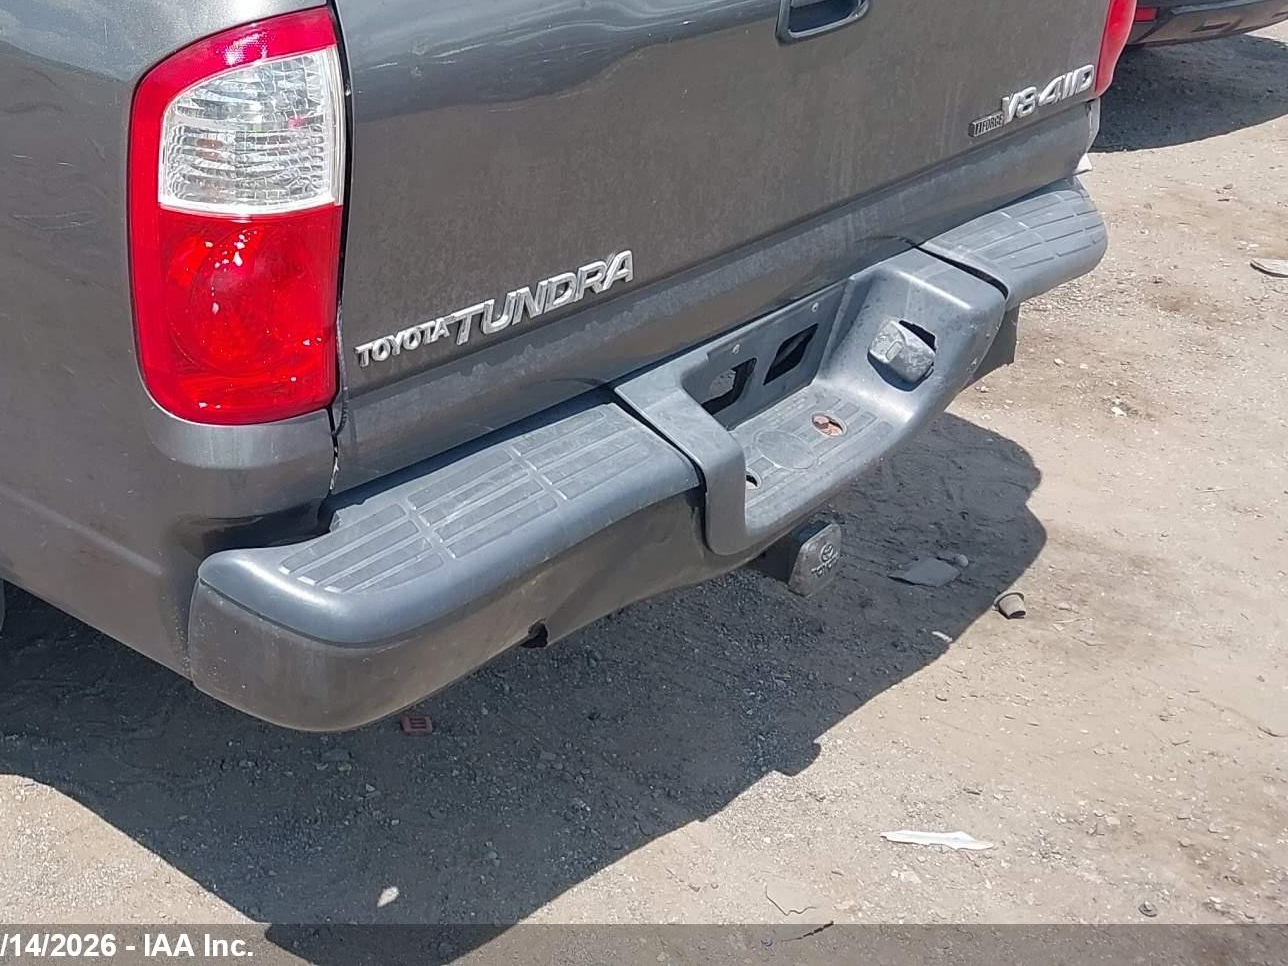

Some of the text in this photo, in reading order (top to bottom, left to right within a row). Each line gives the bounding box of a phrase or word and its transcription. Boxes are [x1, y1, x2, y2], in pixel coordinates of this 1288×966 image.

[1003, 87, 1038, 123] V8
[1039, 64, 1095, 106] 4WD
[354, 250, 634, 368] TOYOTA TUNDRA
